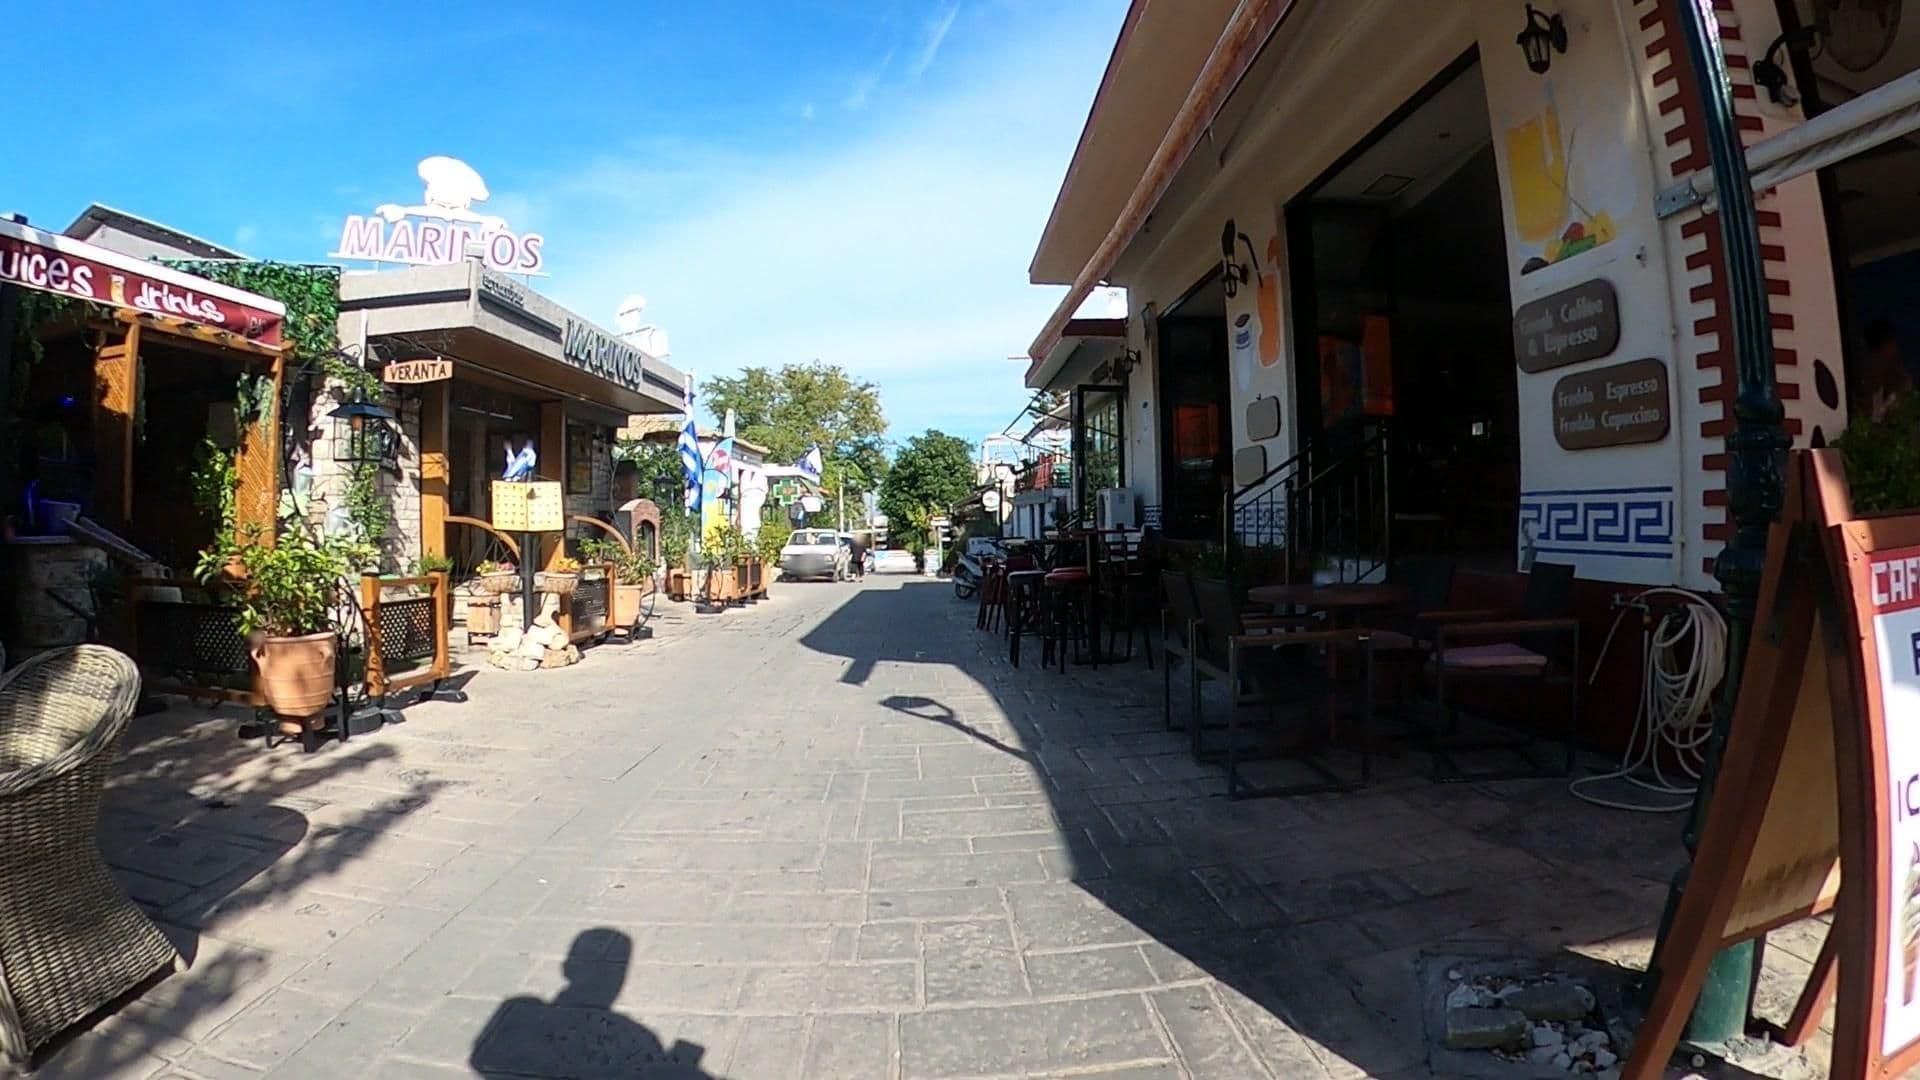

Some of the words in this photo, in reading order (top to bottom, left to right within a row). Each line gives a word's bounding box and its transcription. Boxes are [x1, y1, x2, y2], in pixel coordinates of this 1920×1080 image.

[134, 281, 225, 323] drinks
[564, 317, 641, 386] MARINOS
[390, 363, 447, 380] VERANTA
[1559, 385, 1594, 408] Freddo
[1606, 378, 1658, 403] Espresso
[1560, 411, 1596, 433] Freddo
[1871, 557, 1920, 605] CAF
